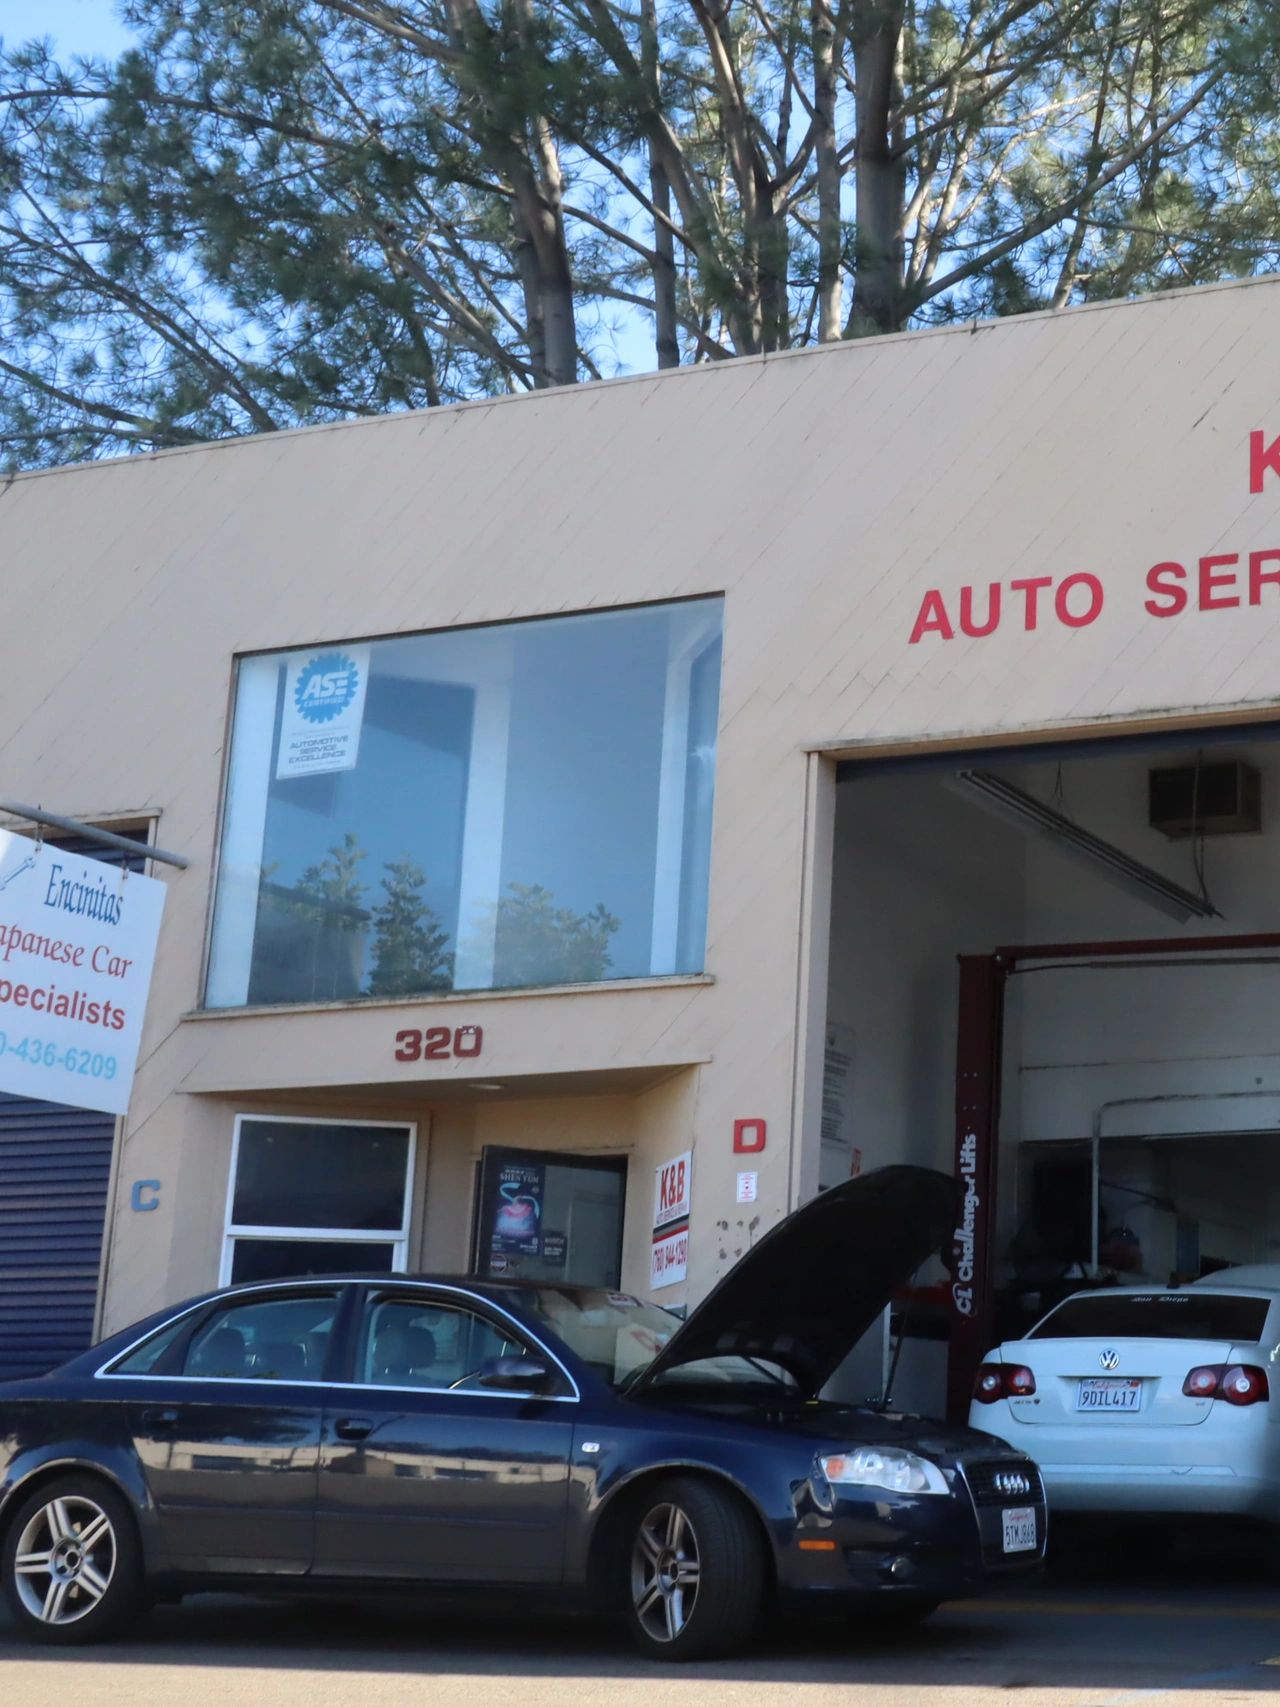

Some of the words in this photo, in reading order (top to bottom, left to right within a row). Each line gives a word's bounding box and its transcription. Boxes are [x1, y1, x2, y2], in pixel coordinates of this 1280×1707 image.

[909, 573, 1105, 644] AUTO
[302, 671, 350, 698] ASE
[288, 750, 346, 764] EXCELLENCE
[289, 735, 348, 749] AUTOMOTIVE
[299, 744, 337, 755] SERVICE
[44, 863, 123, 925] Encinitas
[92, 945, 132, 979] Car
[395, 1025, 483, 1062] 320
[733, 1118, 767, 1153] D
[960, 1133, 977, 1173] Lifts
[499, 1172, 521, 1182] SHEN
[522, 1174, 539, 1183] YUN
[660, 1160, 685, 1211] K&B
[131, 1179, 161, 1212] C
[1082, 1390, 1137, 1407] 9DIL417
